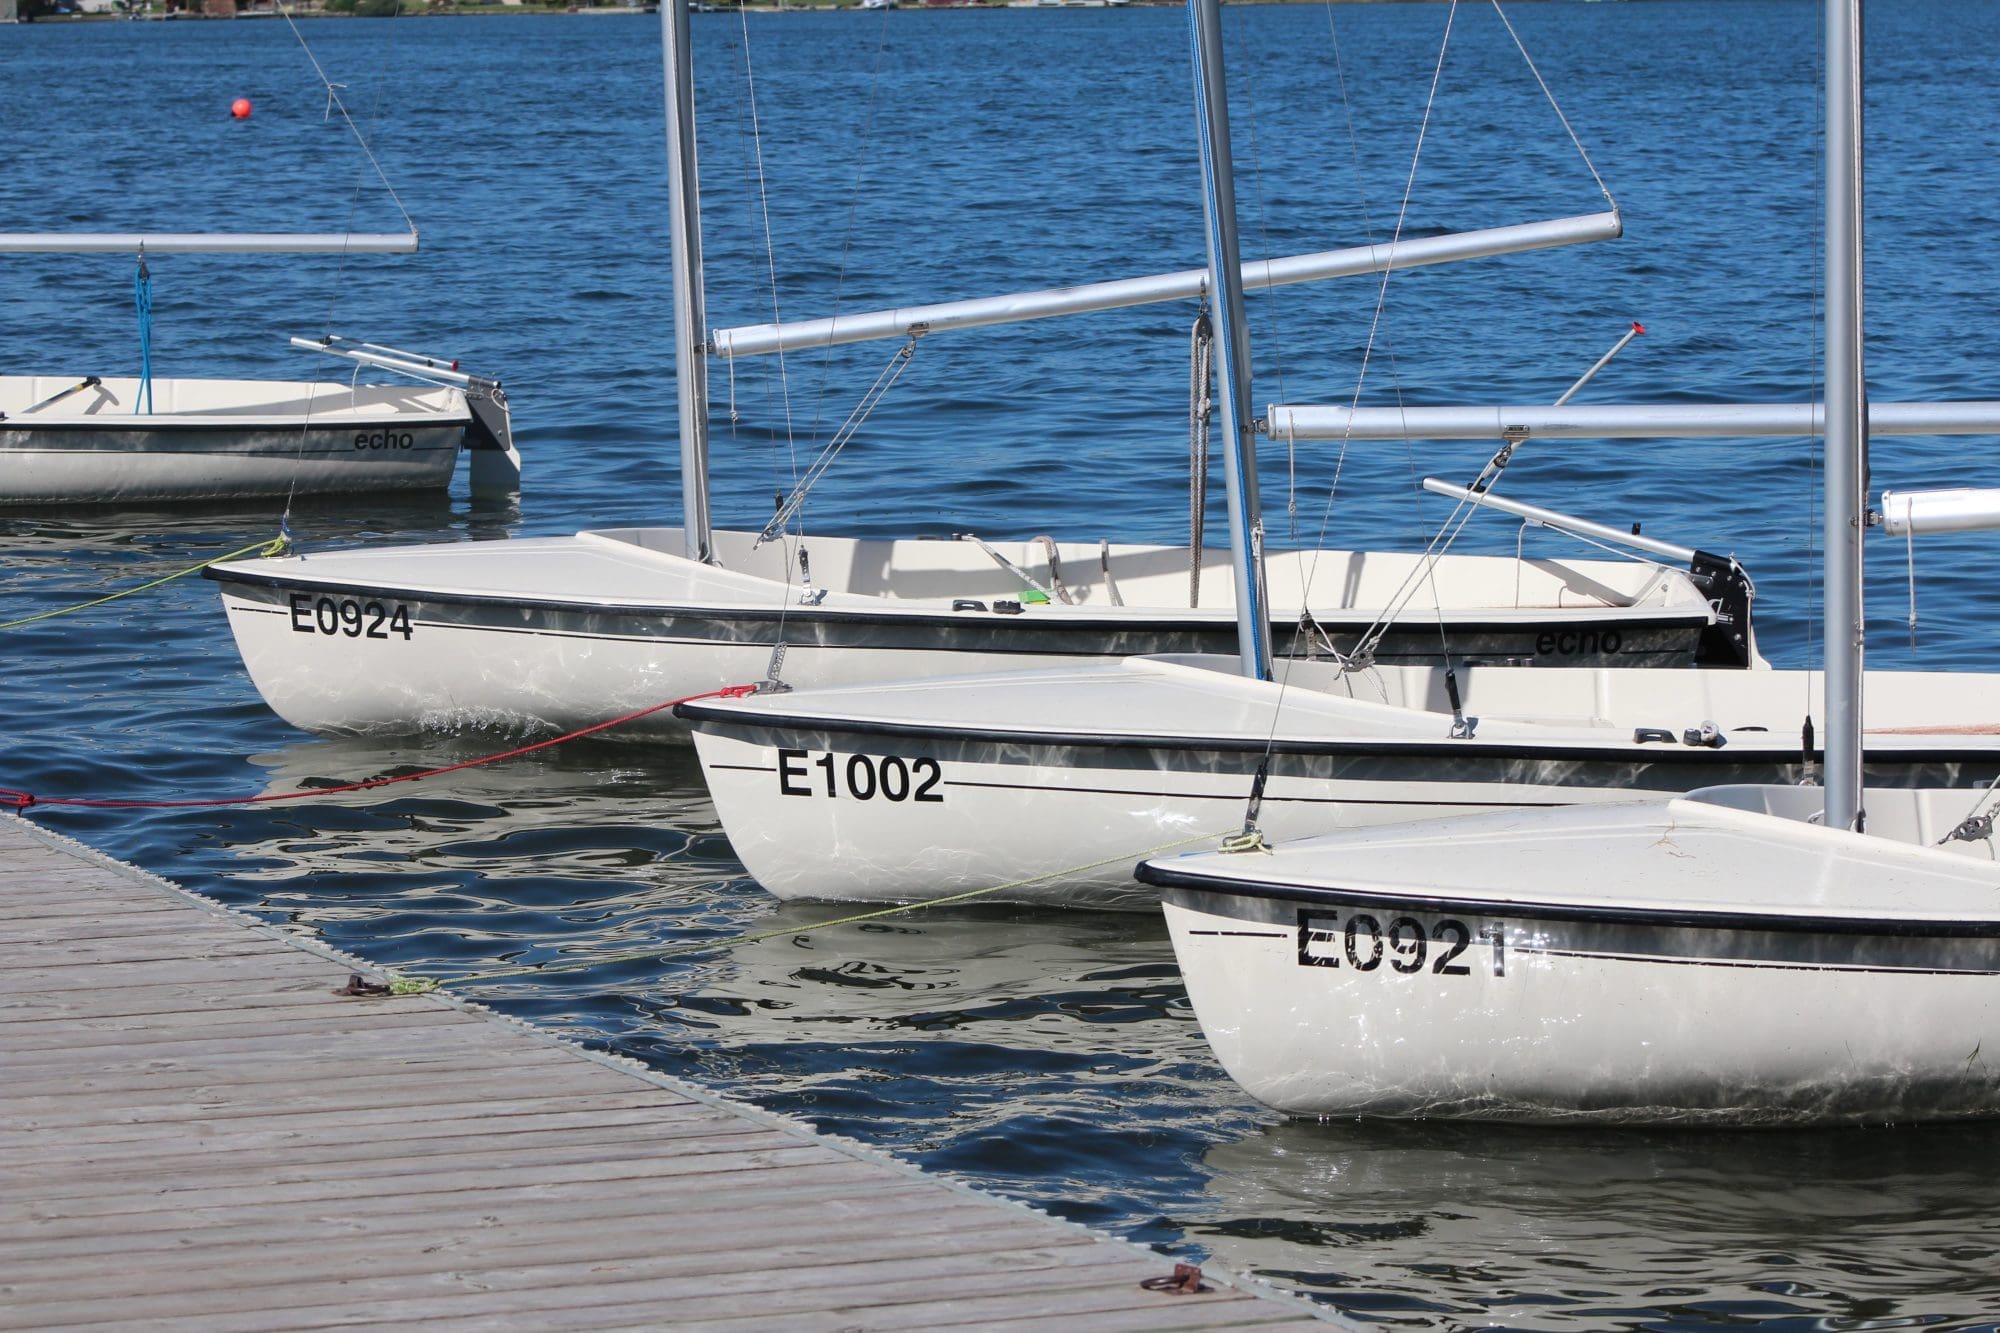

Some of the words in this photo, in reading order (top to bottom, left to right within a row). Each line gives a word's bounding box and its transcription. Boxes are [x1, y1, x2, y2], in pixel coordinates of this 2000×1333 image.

[354, 428, 414, 450] echo
[289, 593, 413, 640] E0924
[778, 749, 944, 802] E1002
[1297, 908, 1505, 977] E0921
